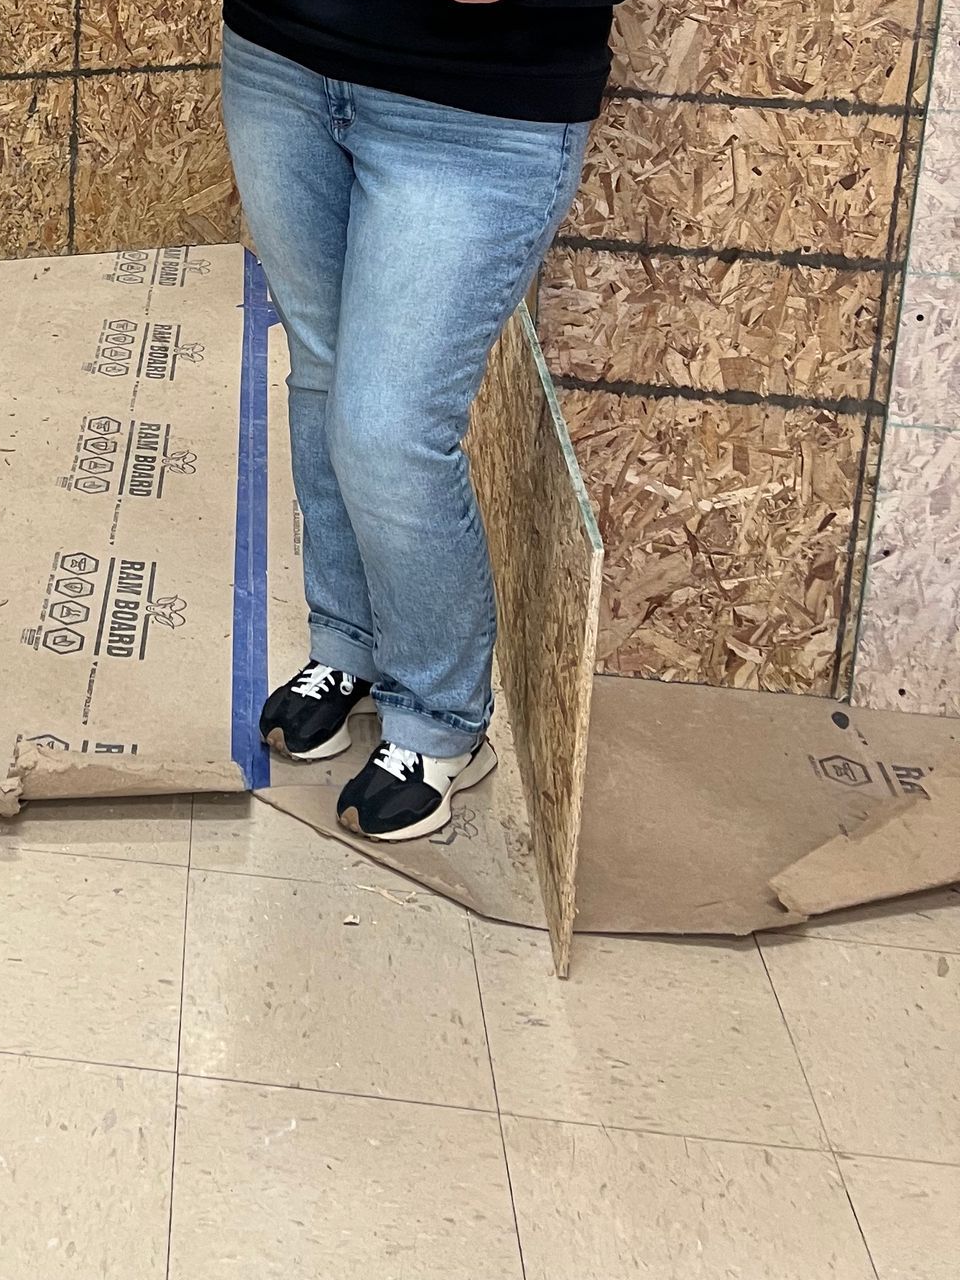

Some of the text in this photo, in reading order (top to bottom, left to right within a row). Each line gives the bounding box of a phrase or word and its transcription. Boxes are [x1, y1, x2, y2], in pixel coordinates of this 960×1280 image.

[159, 262, 179, 286] BOARD
[145, 324, 172, 380] RAM BOARD
[129, 422, 161, 497] RAM BOARD
[106, 559, 145, 658] RAM BOARD
[891, 764, 932, 800] RA
